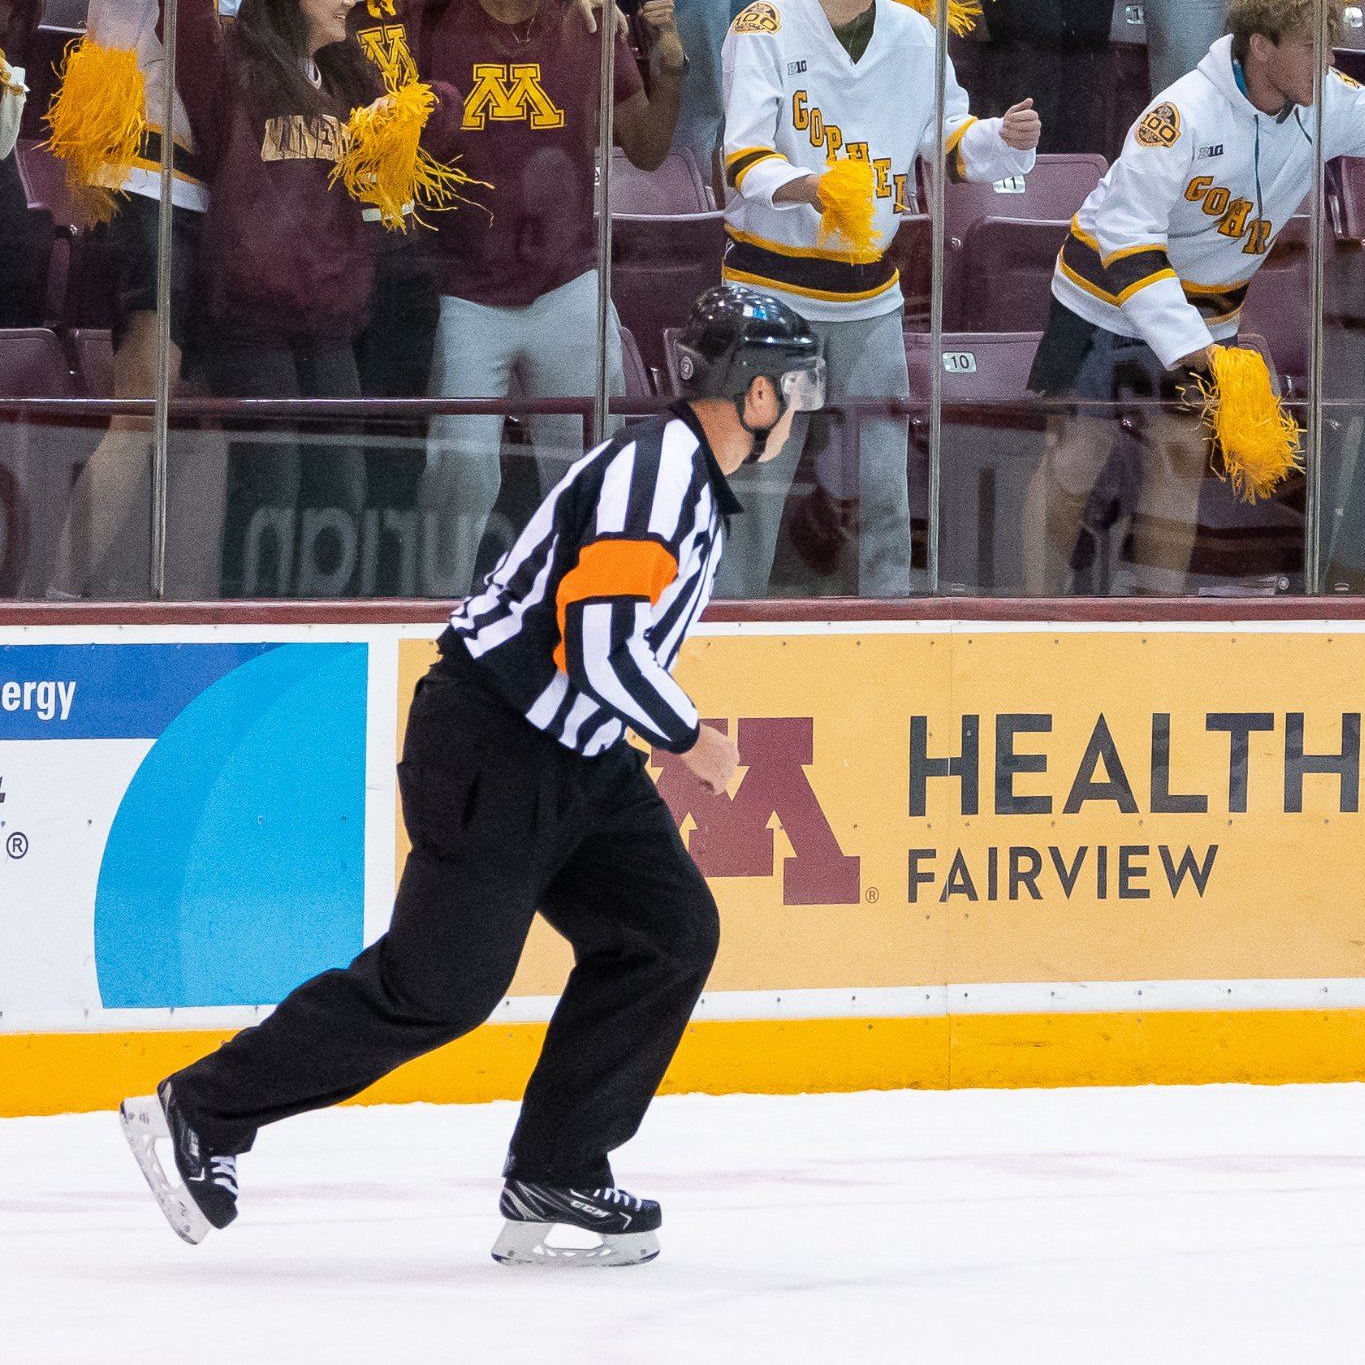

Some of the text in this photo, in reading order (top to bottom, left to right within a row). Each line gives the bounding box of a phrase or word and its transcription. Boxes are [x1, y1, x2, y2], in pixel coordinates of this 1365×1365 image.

[459, 63, 564, 131] M
[949, 353, 968, 370] 10
[0, 680, 77, 721] ergy
[907, 712, 1361, 818] HEALTH
[651, 717, 859, 906] M
[906, 843, 1220, 905] FAIRVIEW
[570, 1199, 610, 1219] CCM
